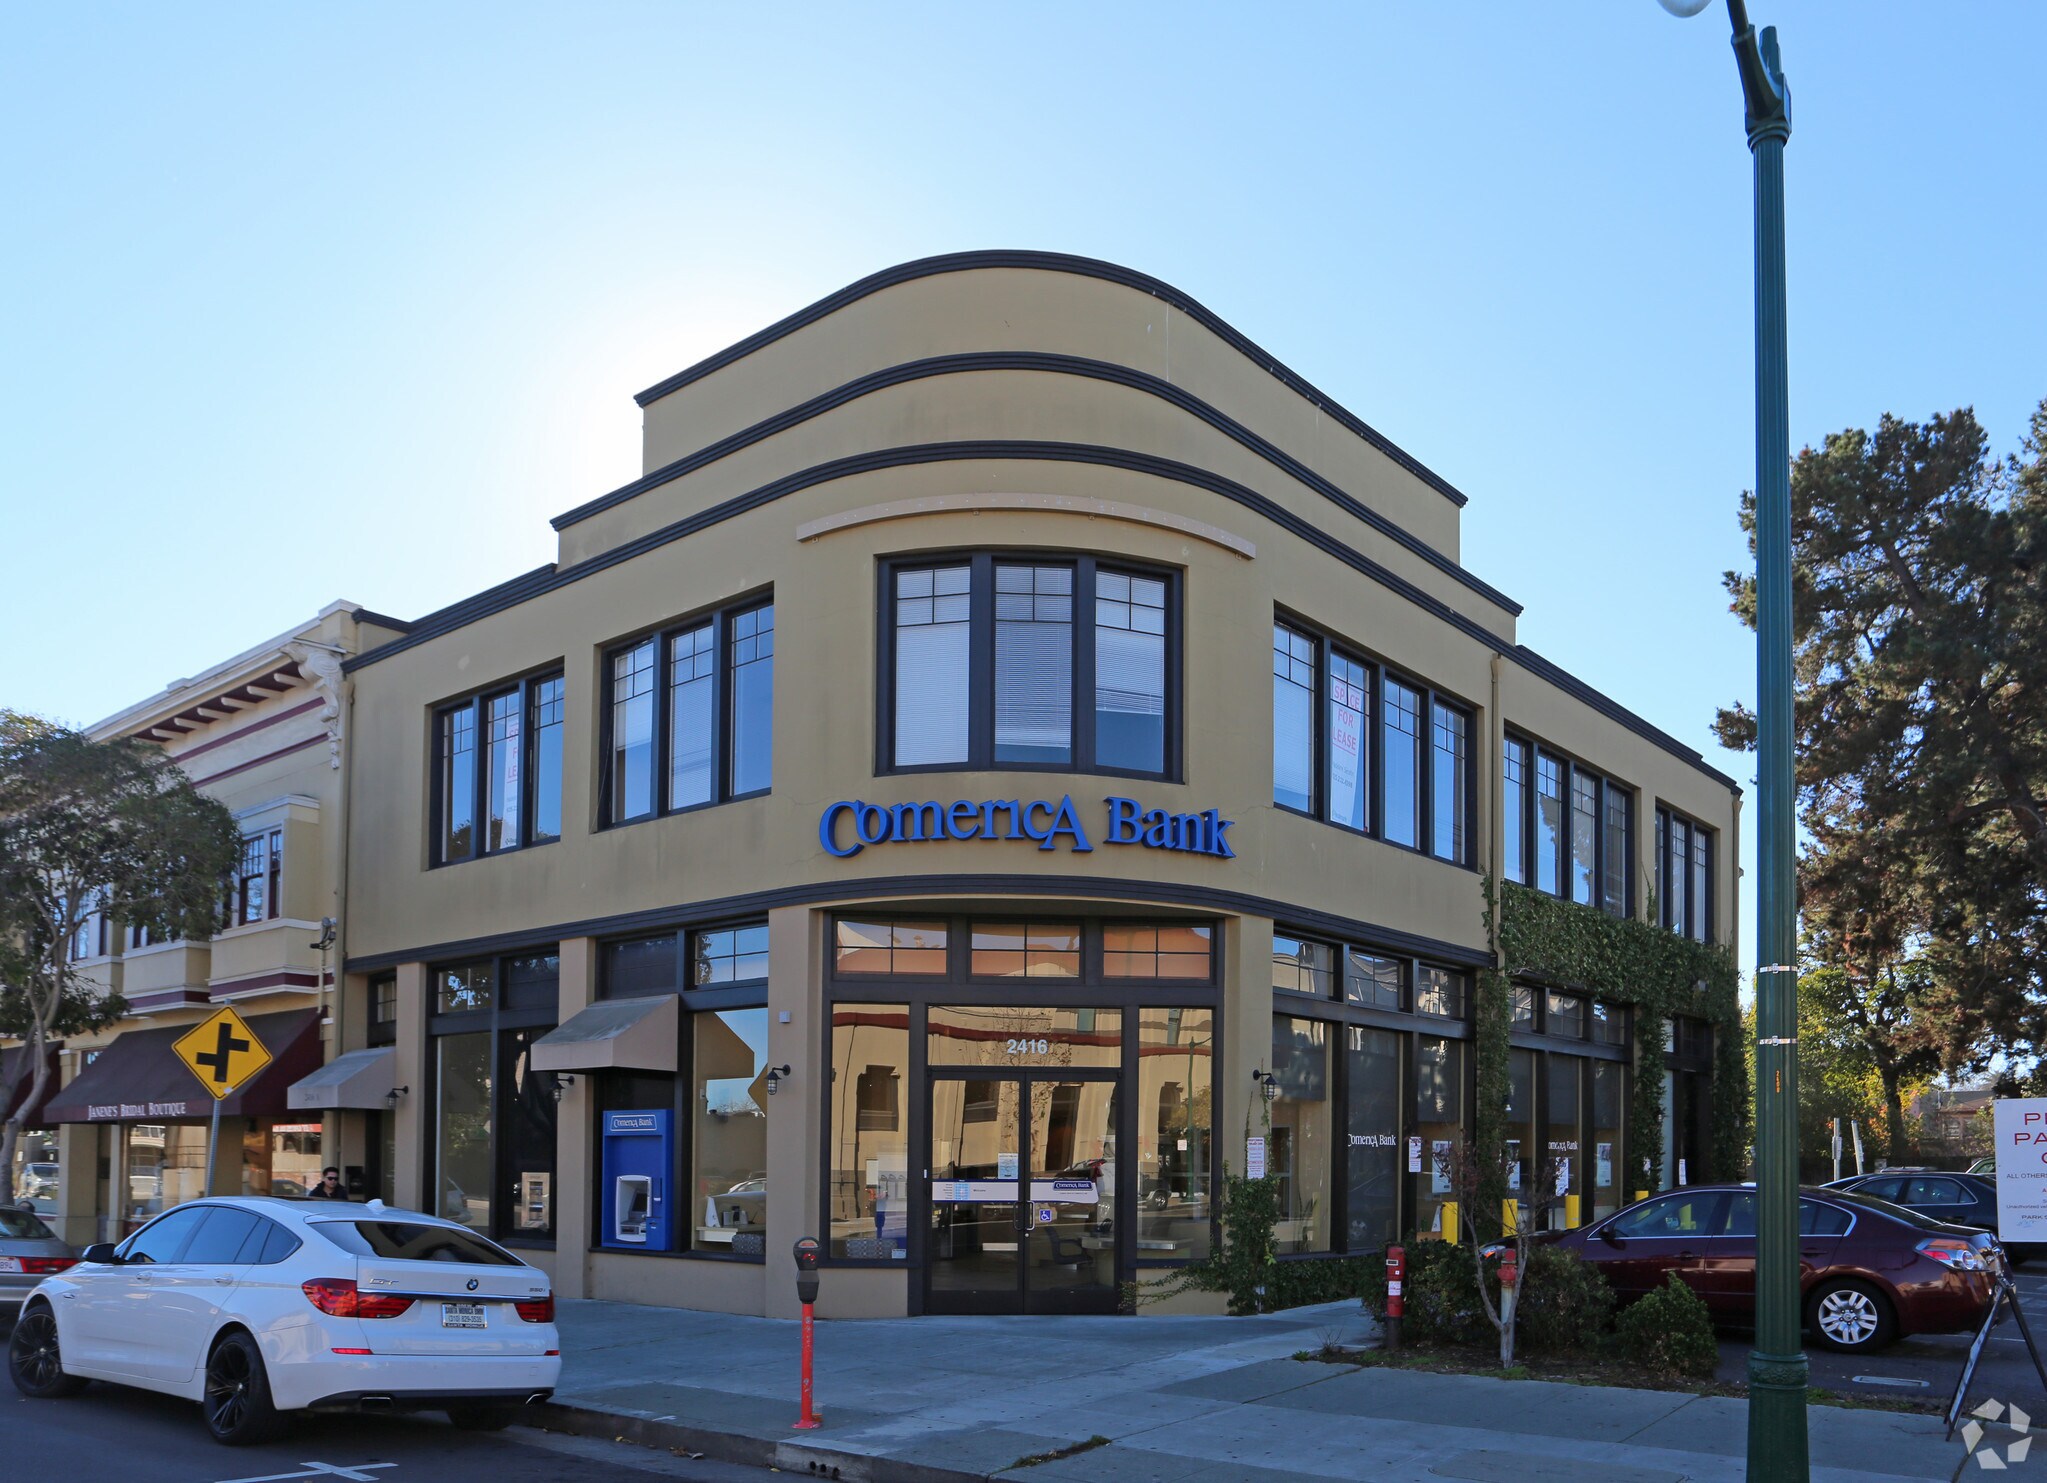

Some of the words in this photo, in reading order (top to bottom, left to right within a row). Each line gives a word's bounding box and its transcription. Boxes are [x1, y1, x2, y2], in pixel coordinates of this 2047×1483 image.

[1338, 708, 1354, 728] FOR
[1103, 796, 1236, 858] Bank
[1007, 1039, 1048, 1055] 2416
[120, 1104, 146, 1116] BRIDAL
[148, 1102, 186, 1116] BOUTIQUE
[639, 1118, 653, 1126] Bank
[2024, 1112, 2047, 1125] P
[1379, 1134, 1396, 1146] Bank
